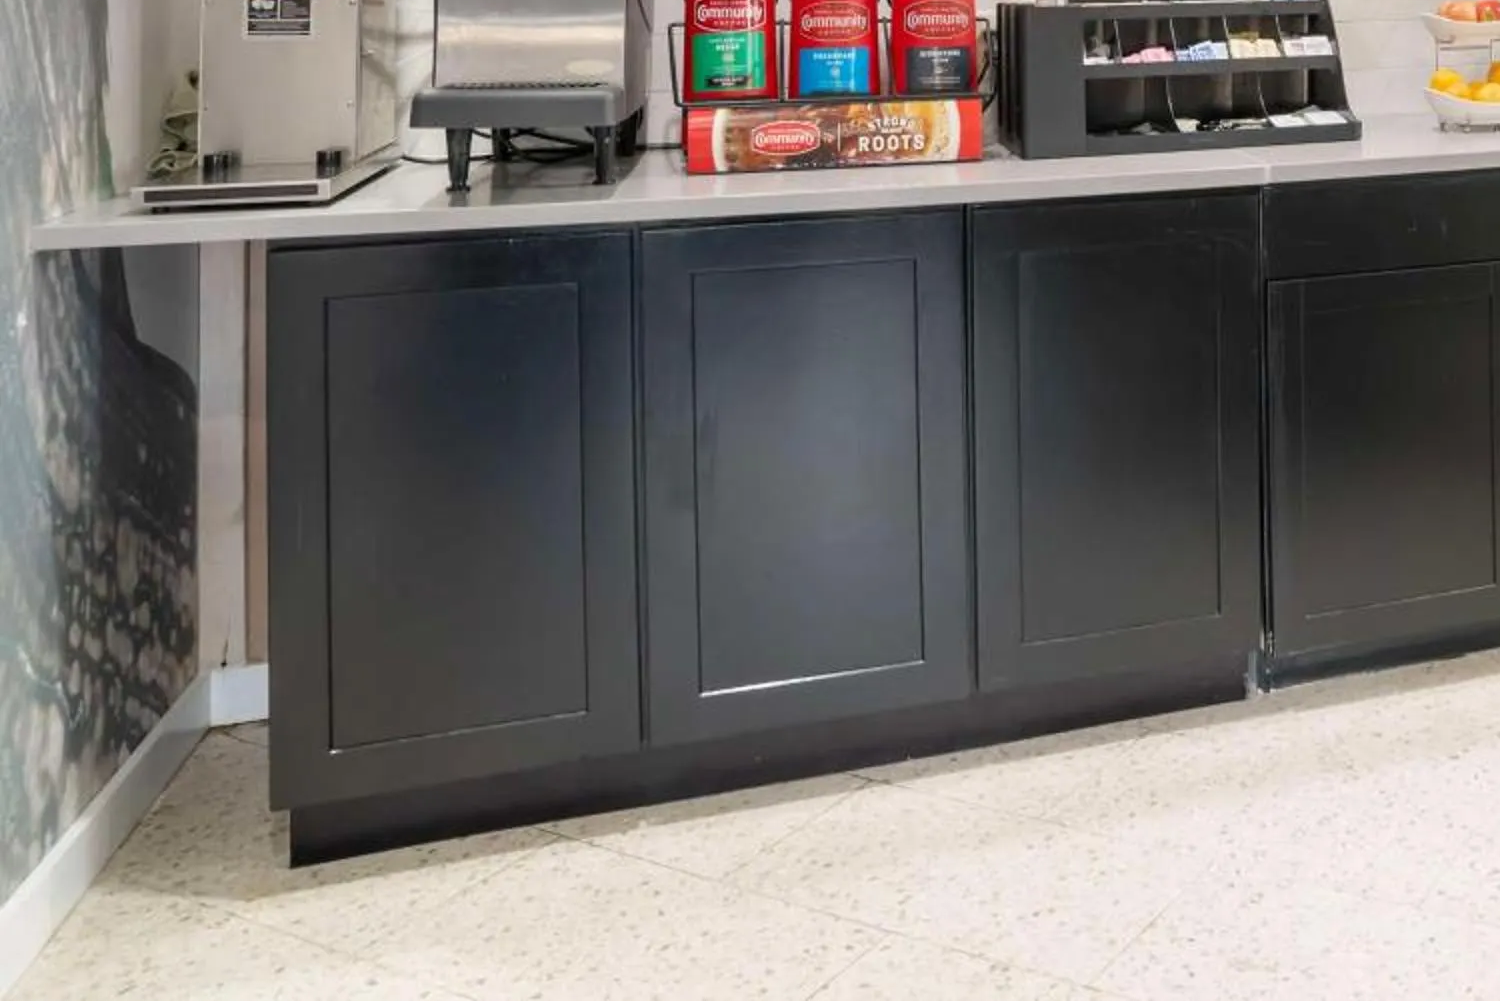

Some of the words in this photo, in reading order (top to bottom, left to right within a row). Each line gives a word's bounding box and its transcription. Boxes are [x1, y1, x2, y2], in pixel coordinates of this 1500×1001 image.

[698, 4, 763, 22] Community
[802, 13, 867, 32] Community
[907, 10, 969, 30] Community
[755, 132, 815, 148] Community
[858, 133, 925, 152] ROOTS
